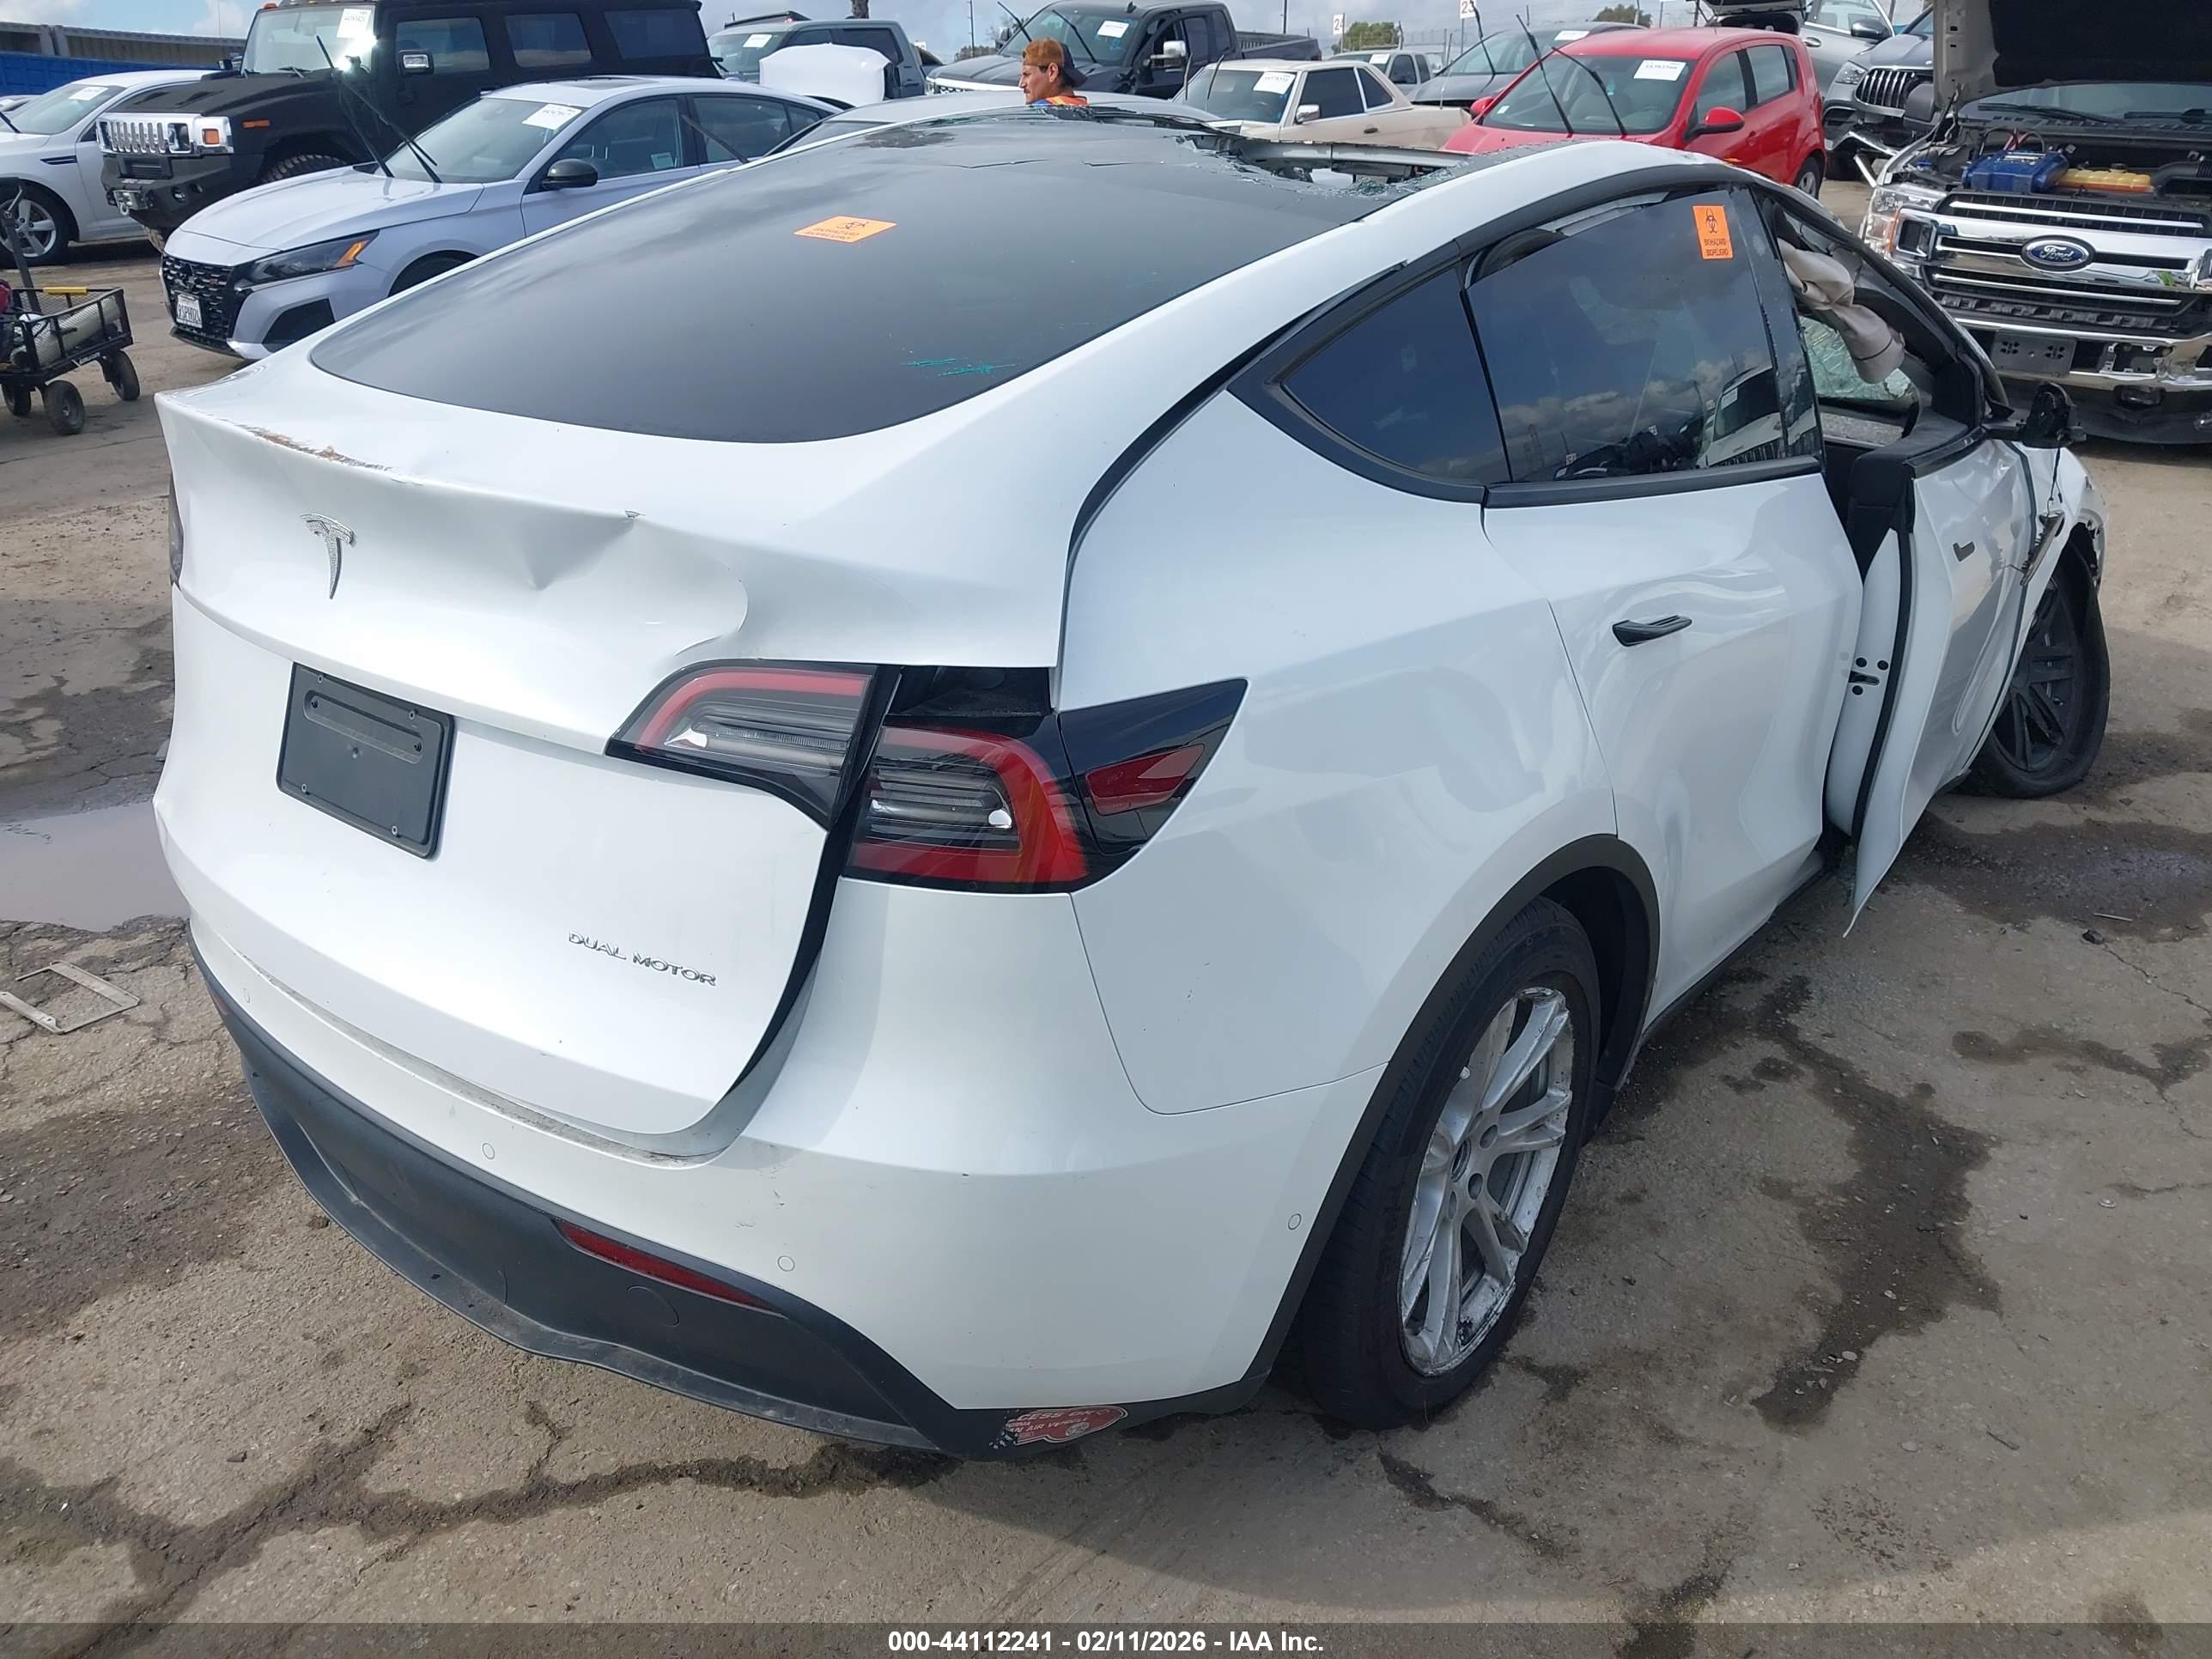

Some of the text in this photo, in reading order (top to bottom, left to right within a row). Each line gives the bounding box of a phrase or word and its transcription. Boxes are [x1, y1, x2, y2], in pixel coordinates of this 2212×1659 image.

[2039, 245, 2075, 262] Ford
[568, 930, 716, 987] DUAL MOTOR
